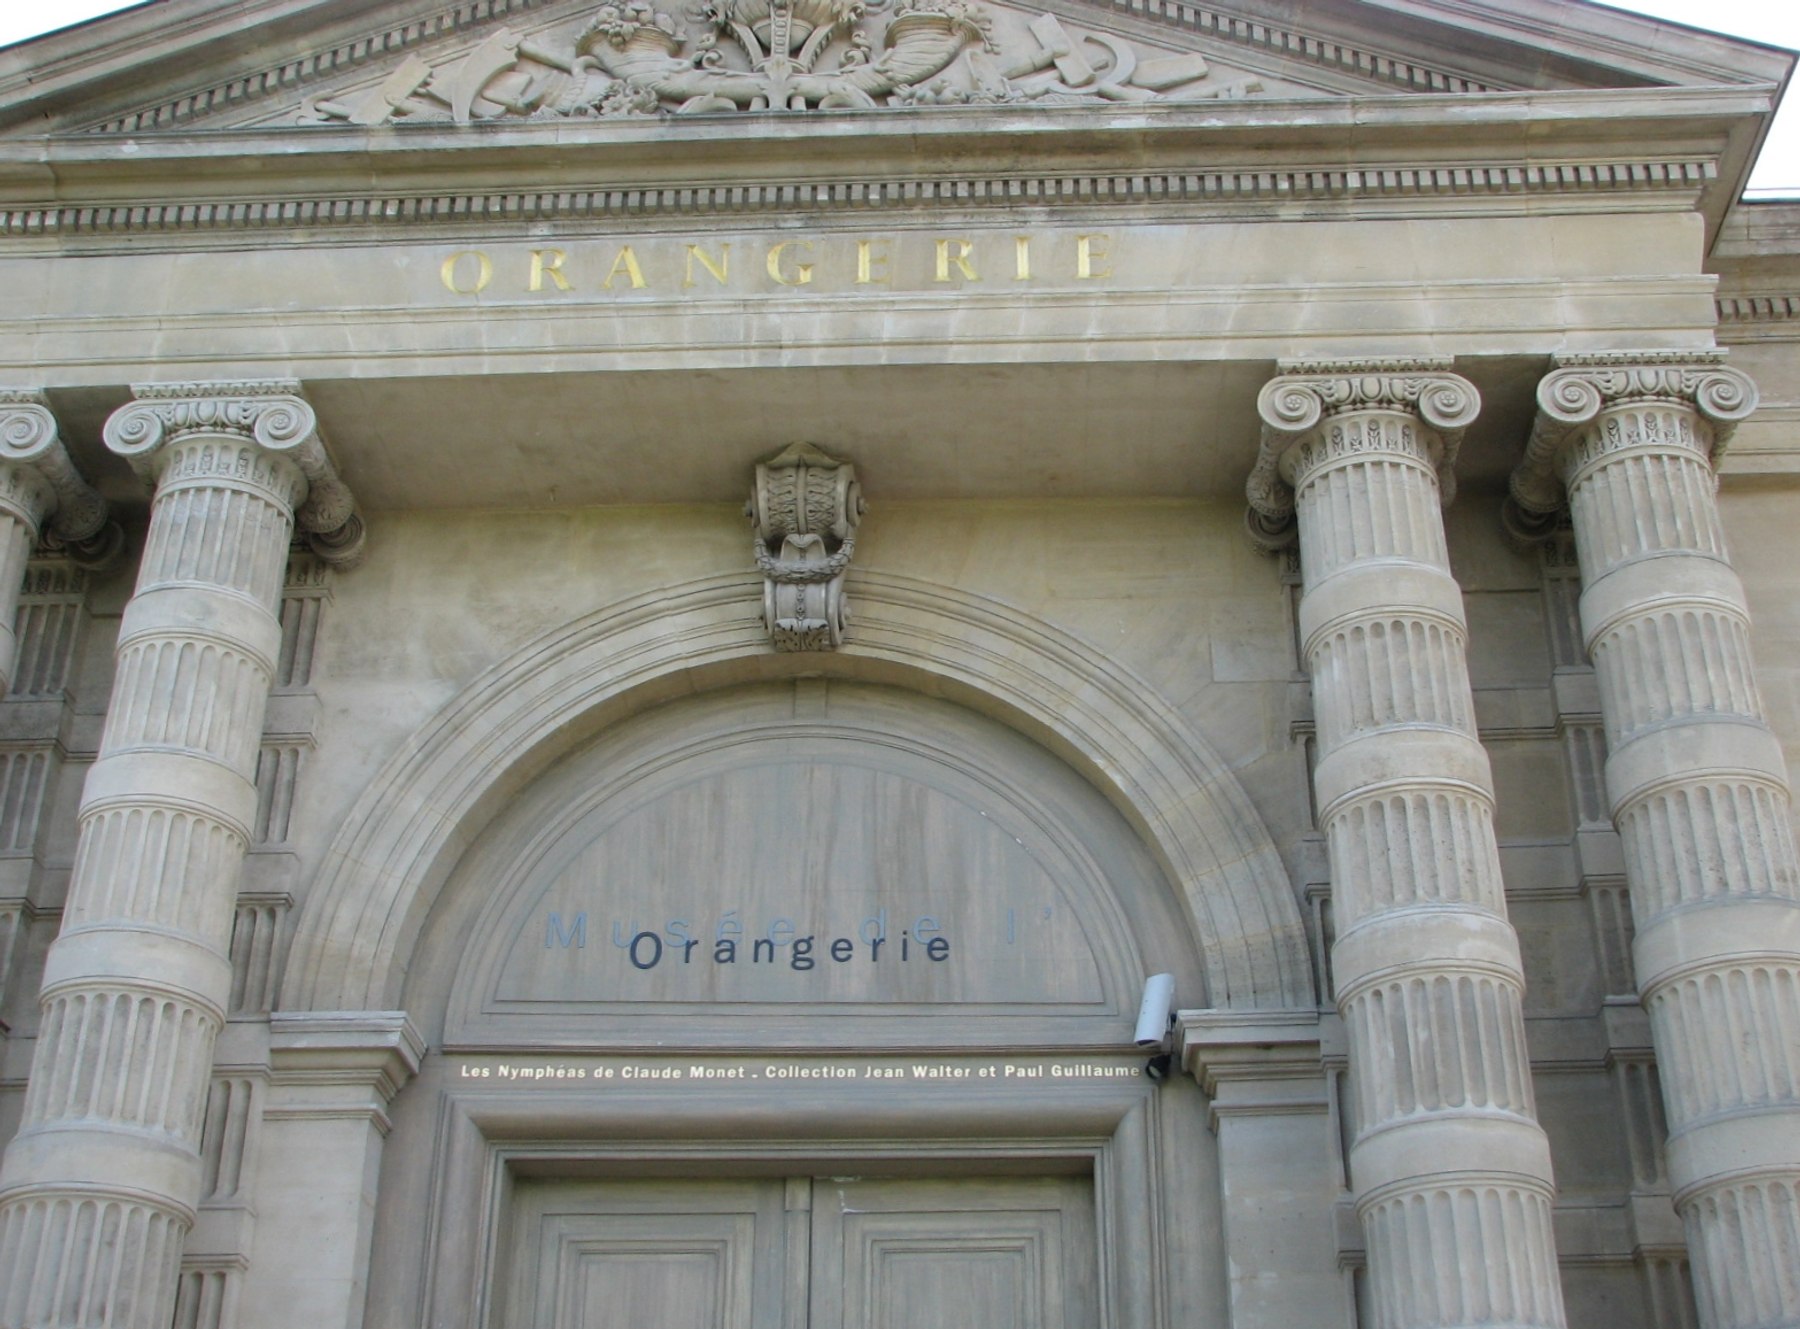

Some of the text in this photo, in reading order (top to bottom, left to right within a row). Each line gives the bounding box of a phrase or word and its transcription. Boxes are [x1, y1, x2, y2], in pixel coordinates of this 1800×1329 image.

[440, 233, 1114, 295] ORANGERIE
[545, 909, 796, 949] Musée
[857, 907, 942, 944] de
[628, 930, 951, 972] Orangerie
[461, 1064, 491, 1078] Les
[498, 1064, 587, 1080] Nymphéas
[593, 1066, 615, 1078] de
[621, 1065, 682, 1079] Claude
[689, 1065, 745, 1078] Monet
[765, 1065, 857, 1079] Collection
[864, 1065, 905, 1078] Jean
[912, 1065, 971, 1078] Walter
[978, 1065, 997, 1078] et
[1004, 1064, 1044, 1077] Paul
[1051, 1064, 1141, 1077] Guillaume
